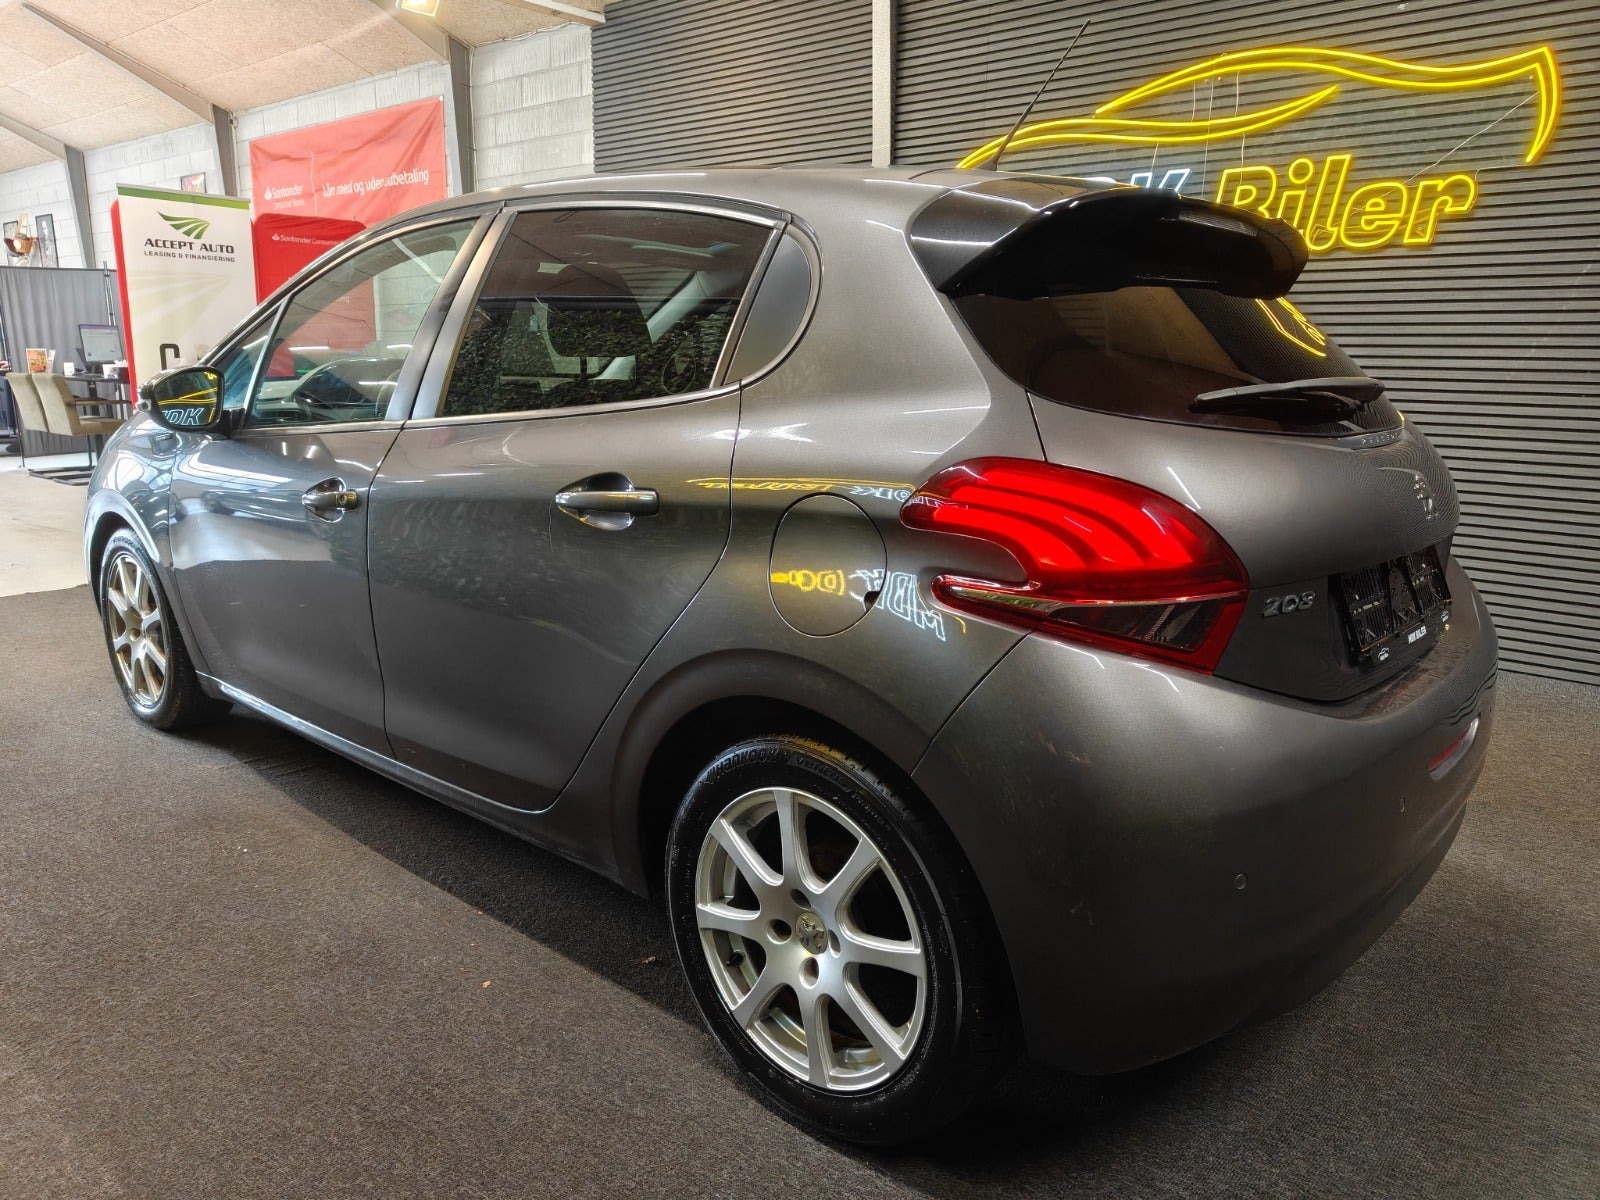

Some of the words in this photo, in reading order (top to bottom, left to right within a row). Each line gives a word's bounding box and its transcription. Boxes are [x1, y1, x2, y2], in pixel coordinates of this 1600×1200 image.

[272, 184, 304, 199] Santander
[335, 179, 353, 195] med
[353, 180, 365, 196] og
[365, 176, 385, 191] uden
[1215, 153, 1476, 252] Biler
[144, 238, 195, 250] ACCEPT
[200, 243, 234, 254] AUTO
[280, 234, 311, 244] Santander
[144, 250, 176, 258] LEASING
[185, 253, 235, 263] FINANSIERING
[1263, 590, 1316, 617] 208
